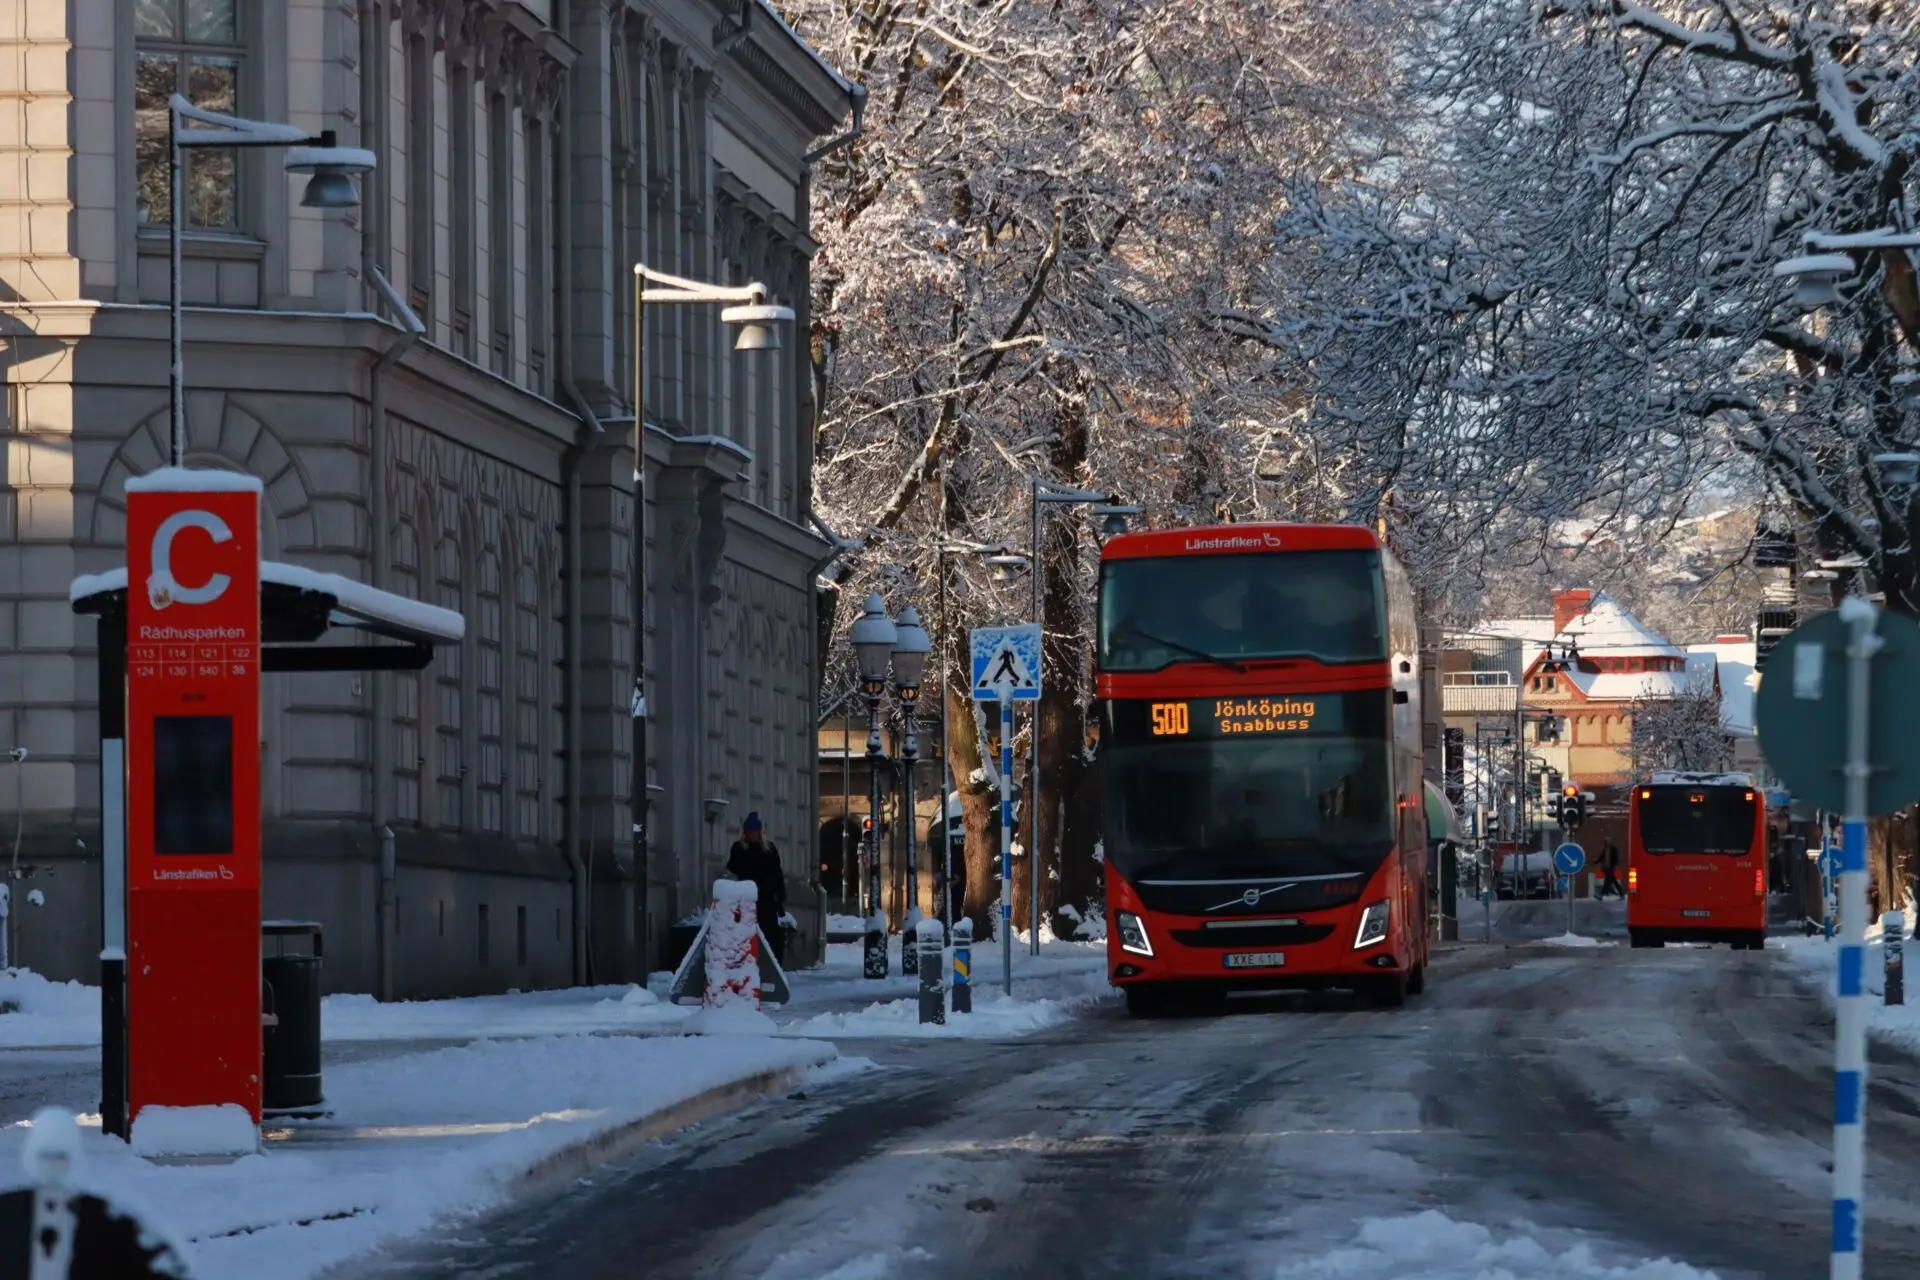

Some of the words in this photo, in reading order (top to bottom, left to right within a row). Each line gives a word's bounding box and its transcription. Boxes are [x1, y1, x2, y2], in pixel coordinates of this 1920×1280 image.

[1185, 536, 1261, 550] Länstrafiken
[151, 509, 233, 604] C
[140, 625, 245, 642] Rådhusparken
[136, 648, 155, 658] 113
[168, 648, 187, 658] 114
[200, 648, 218, 658] 121
[232, 648, 250, 658] 122
[136, 666, 154, 676] 124
[199, 666, 218, 675] 540
[1152, 703, 1189, 735] 500
[1214, 699, 1315, 718] Jönköping
[1221, 719, 1309, 733] Snabbuss
[153, 868, 218, 880] Länstrafiken
